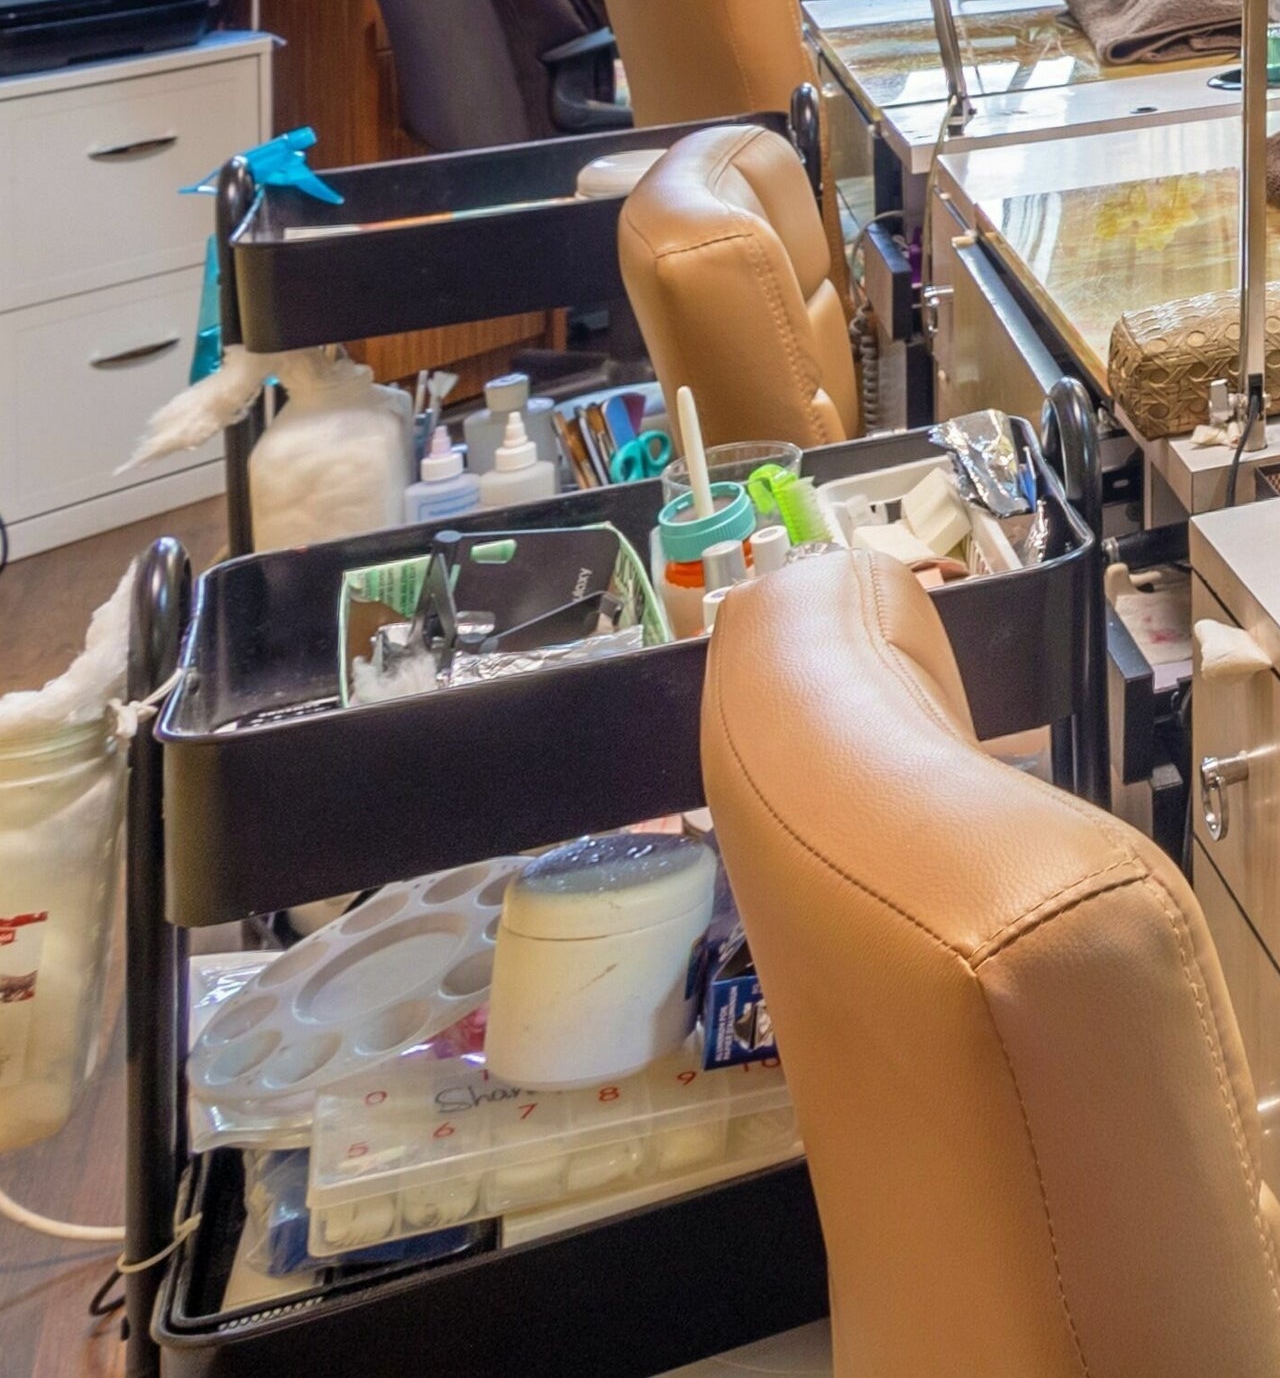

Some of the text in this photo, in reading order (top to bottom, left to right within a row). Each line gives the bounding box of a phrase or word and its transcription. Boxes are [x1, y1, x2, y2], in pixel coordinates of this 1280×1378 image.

[676, 1069, 697, 1086] 9
[364, 1090, 388, 1108] 0
[598, 1085, 620, 1102] 8
[517, 1102, 539, 1120] 7
[433, 1121, 455, 1140] 6
[347, 1141, 369, 1158] 5
